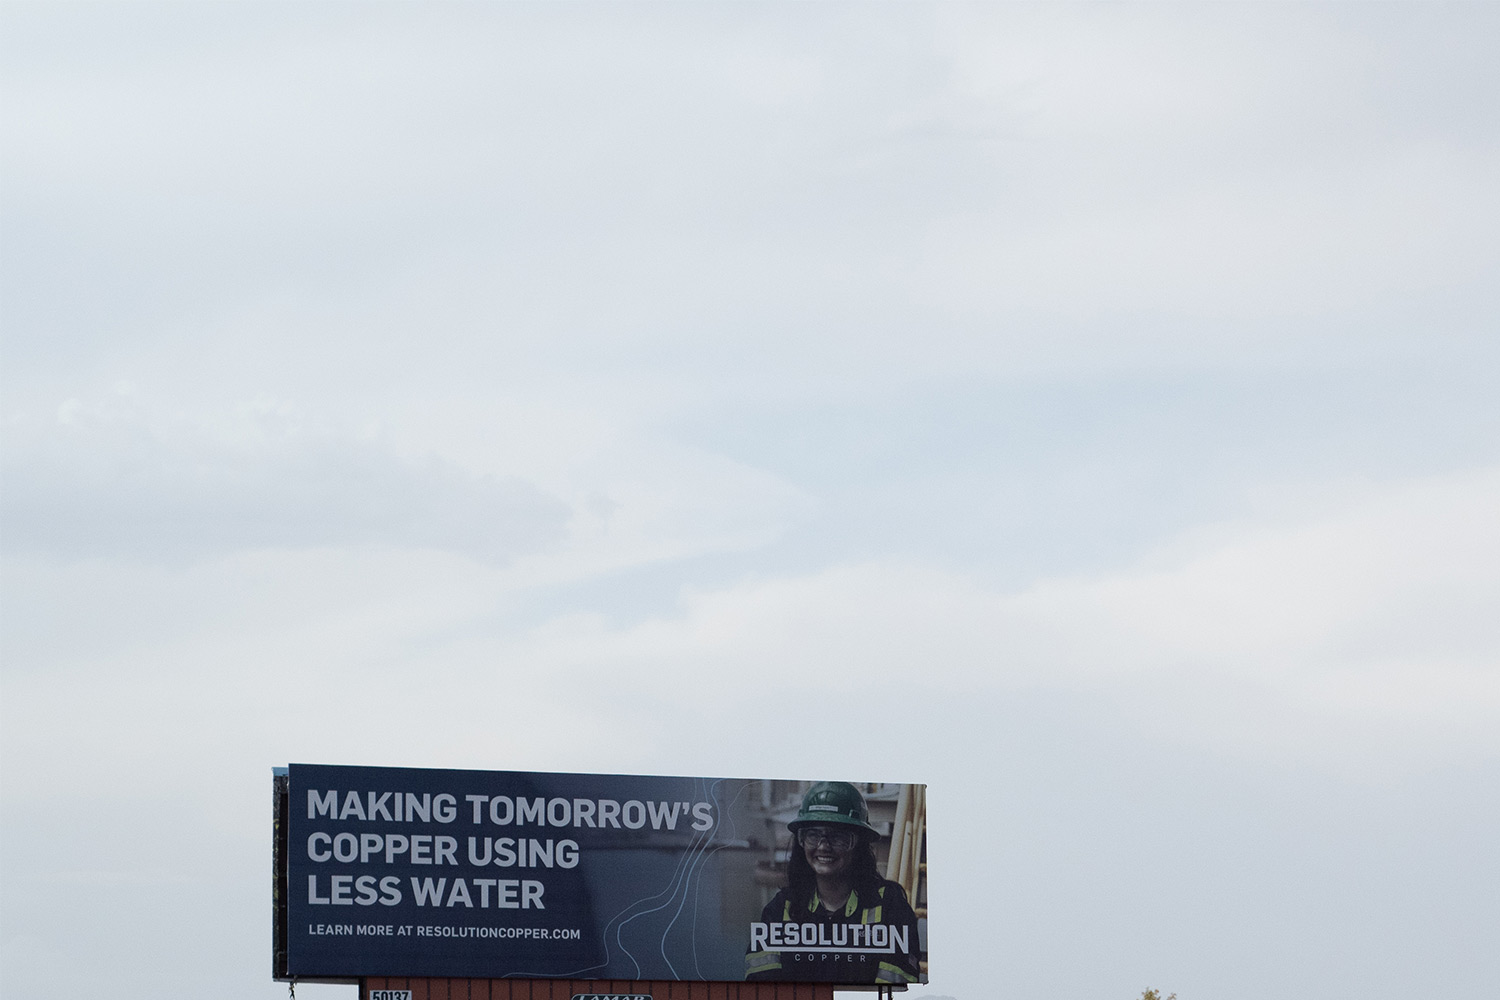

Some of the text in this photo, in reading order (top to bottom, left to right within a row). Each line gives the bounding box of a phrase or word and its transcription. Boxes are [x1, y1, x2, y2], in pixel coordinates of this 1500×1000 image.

[308, 789, 714, 831] MAKING TOMORROW'S
[307, 832, 580, 869] COPPER USING
[309, 875, 546, 910] LESS WATER
[308, 924, 581, 940] LEARN MORE AT RESOLUTIONCOPPER.COM
[750, 922, 909, 955] RESOLUTION
[794, 953, 866, 963] COPPER
